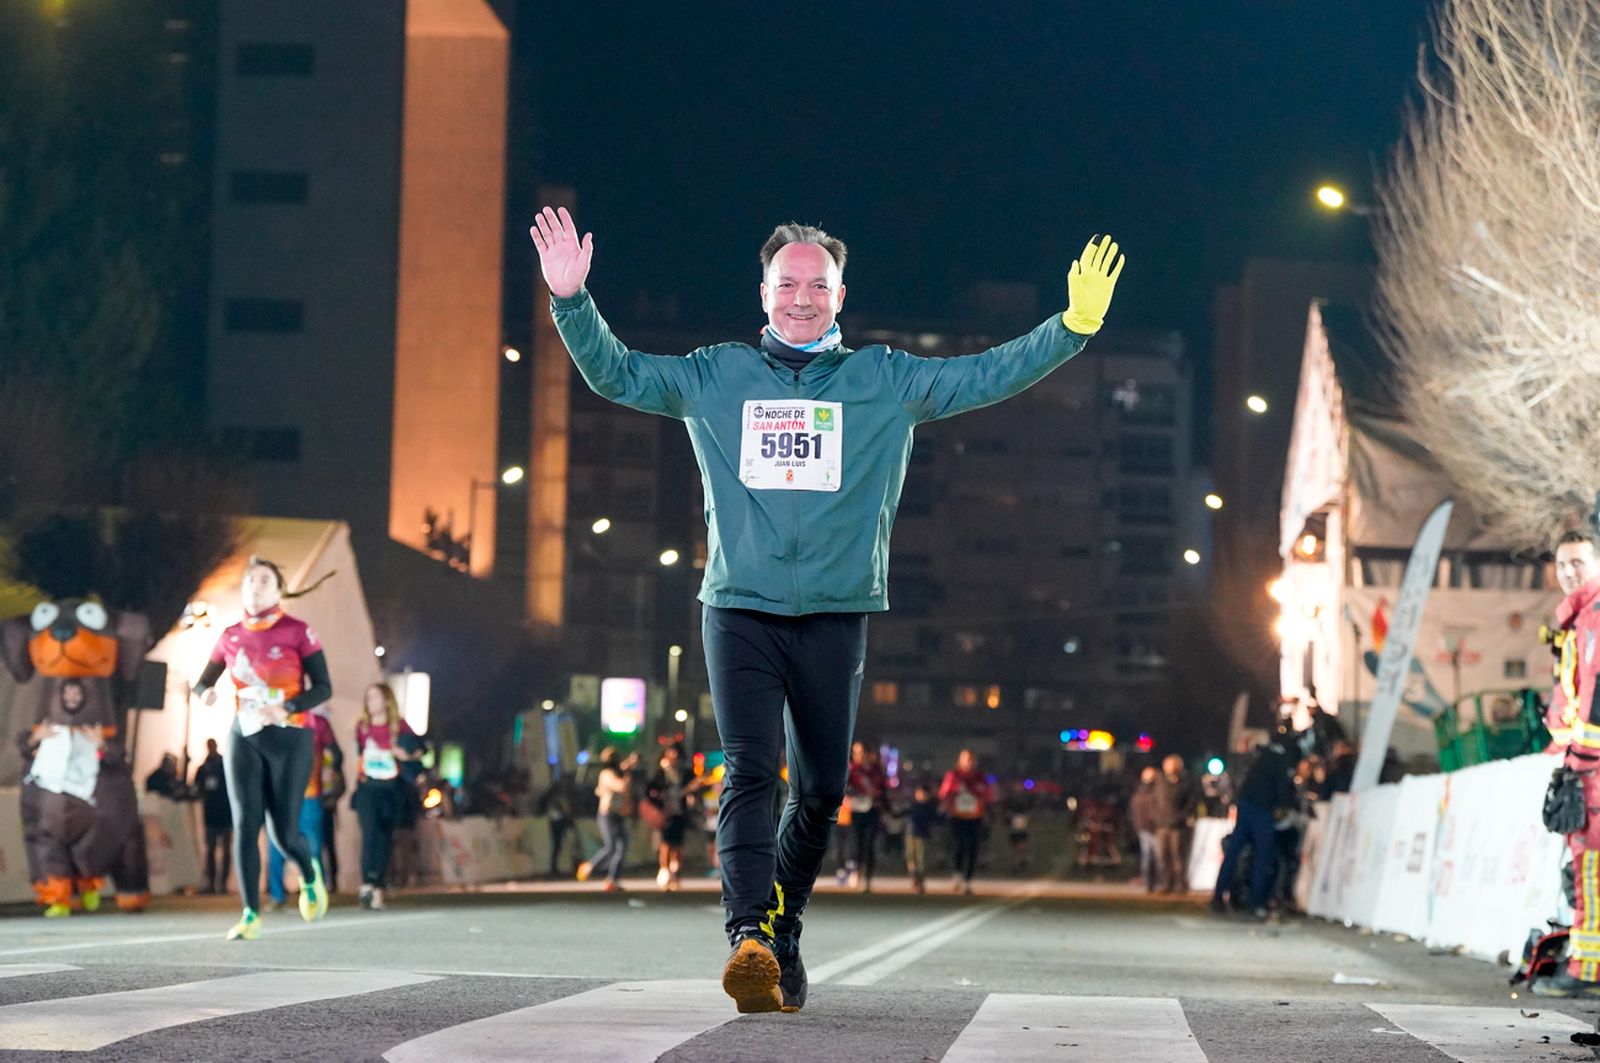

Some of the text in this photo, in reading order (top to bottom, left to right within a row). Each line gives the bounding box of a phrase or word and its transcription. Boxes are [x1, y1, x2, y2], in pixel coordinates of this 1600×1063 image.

[765, 410, 805, 419] NOCHE DE
[753, 421, 772, 430] SAN
[773, 420, 805, 430] ANTÓN
[761, 432, 822, 459] 5951
